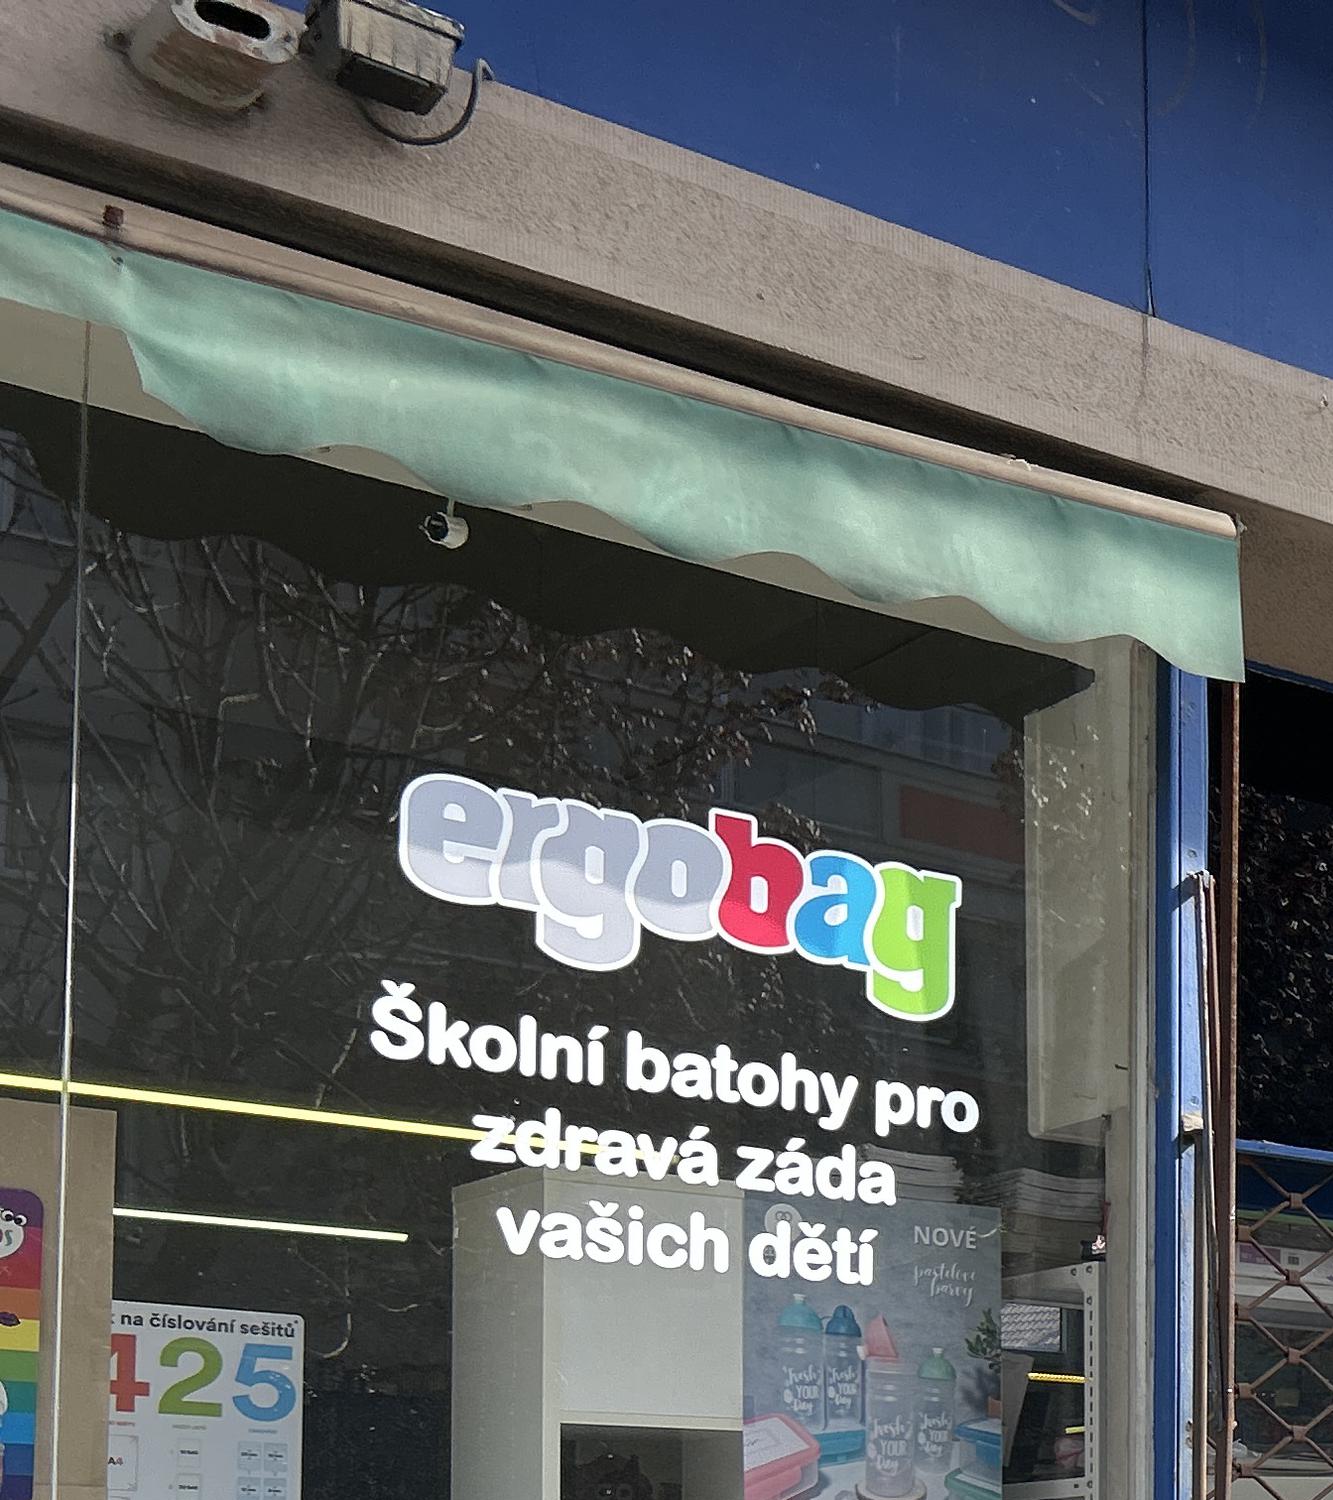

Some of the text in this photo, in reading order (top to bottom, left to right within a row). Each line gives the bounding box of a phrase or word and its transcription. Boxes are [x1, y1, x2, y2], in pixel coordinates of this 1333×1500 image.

[398, 773, 962, 1022] ergobag
[370, 981, 980, 1136] Školní batohy pro
[470, 1109, 897, 1205] zdravá záda
[496, 1200, 880, 1287] vašich dětí
[914, 1225, 977, 1250] NOVÉ
[121, 1313, 144, 1327] na
[149, 1313, 236, 1334] číslování
[110, 1333, 297, 1422] 4 2 5
[879, 1440, 907, 1457] YOUR
